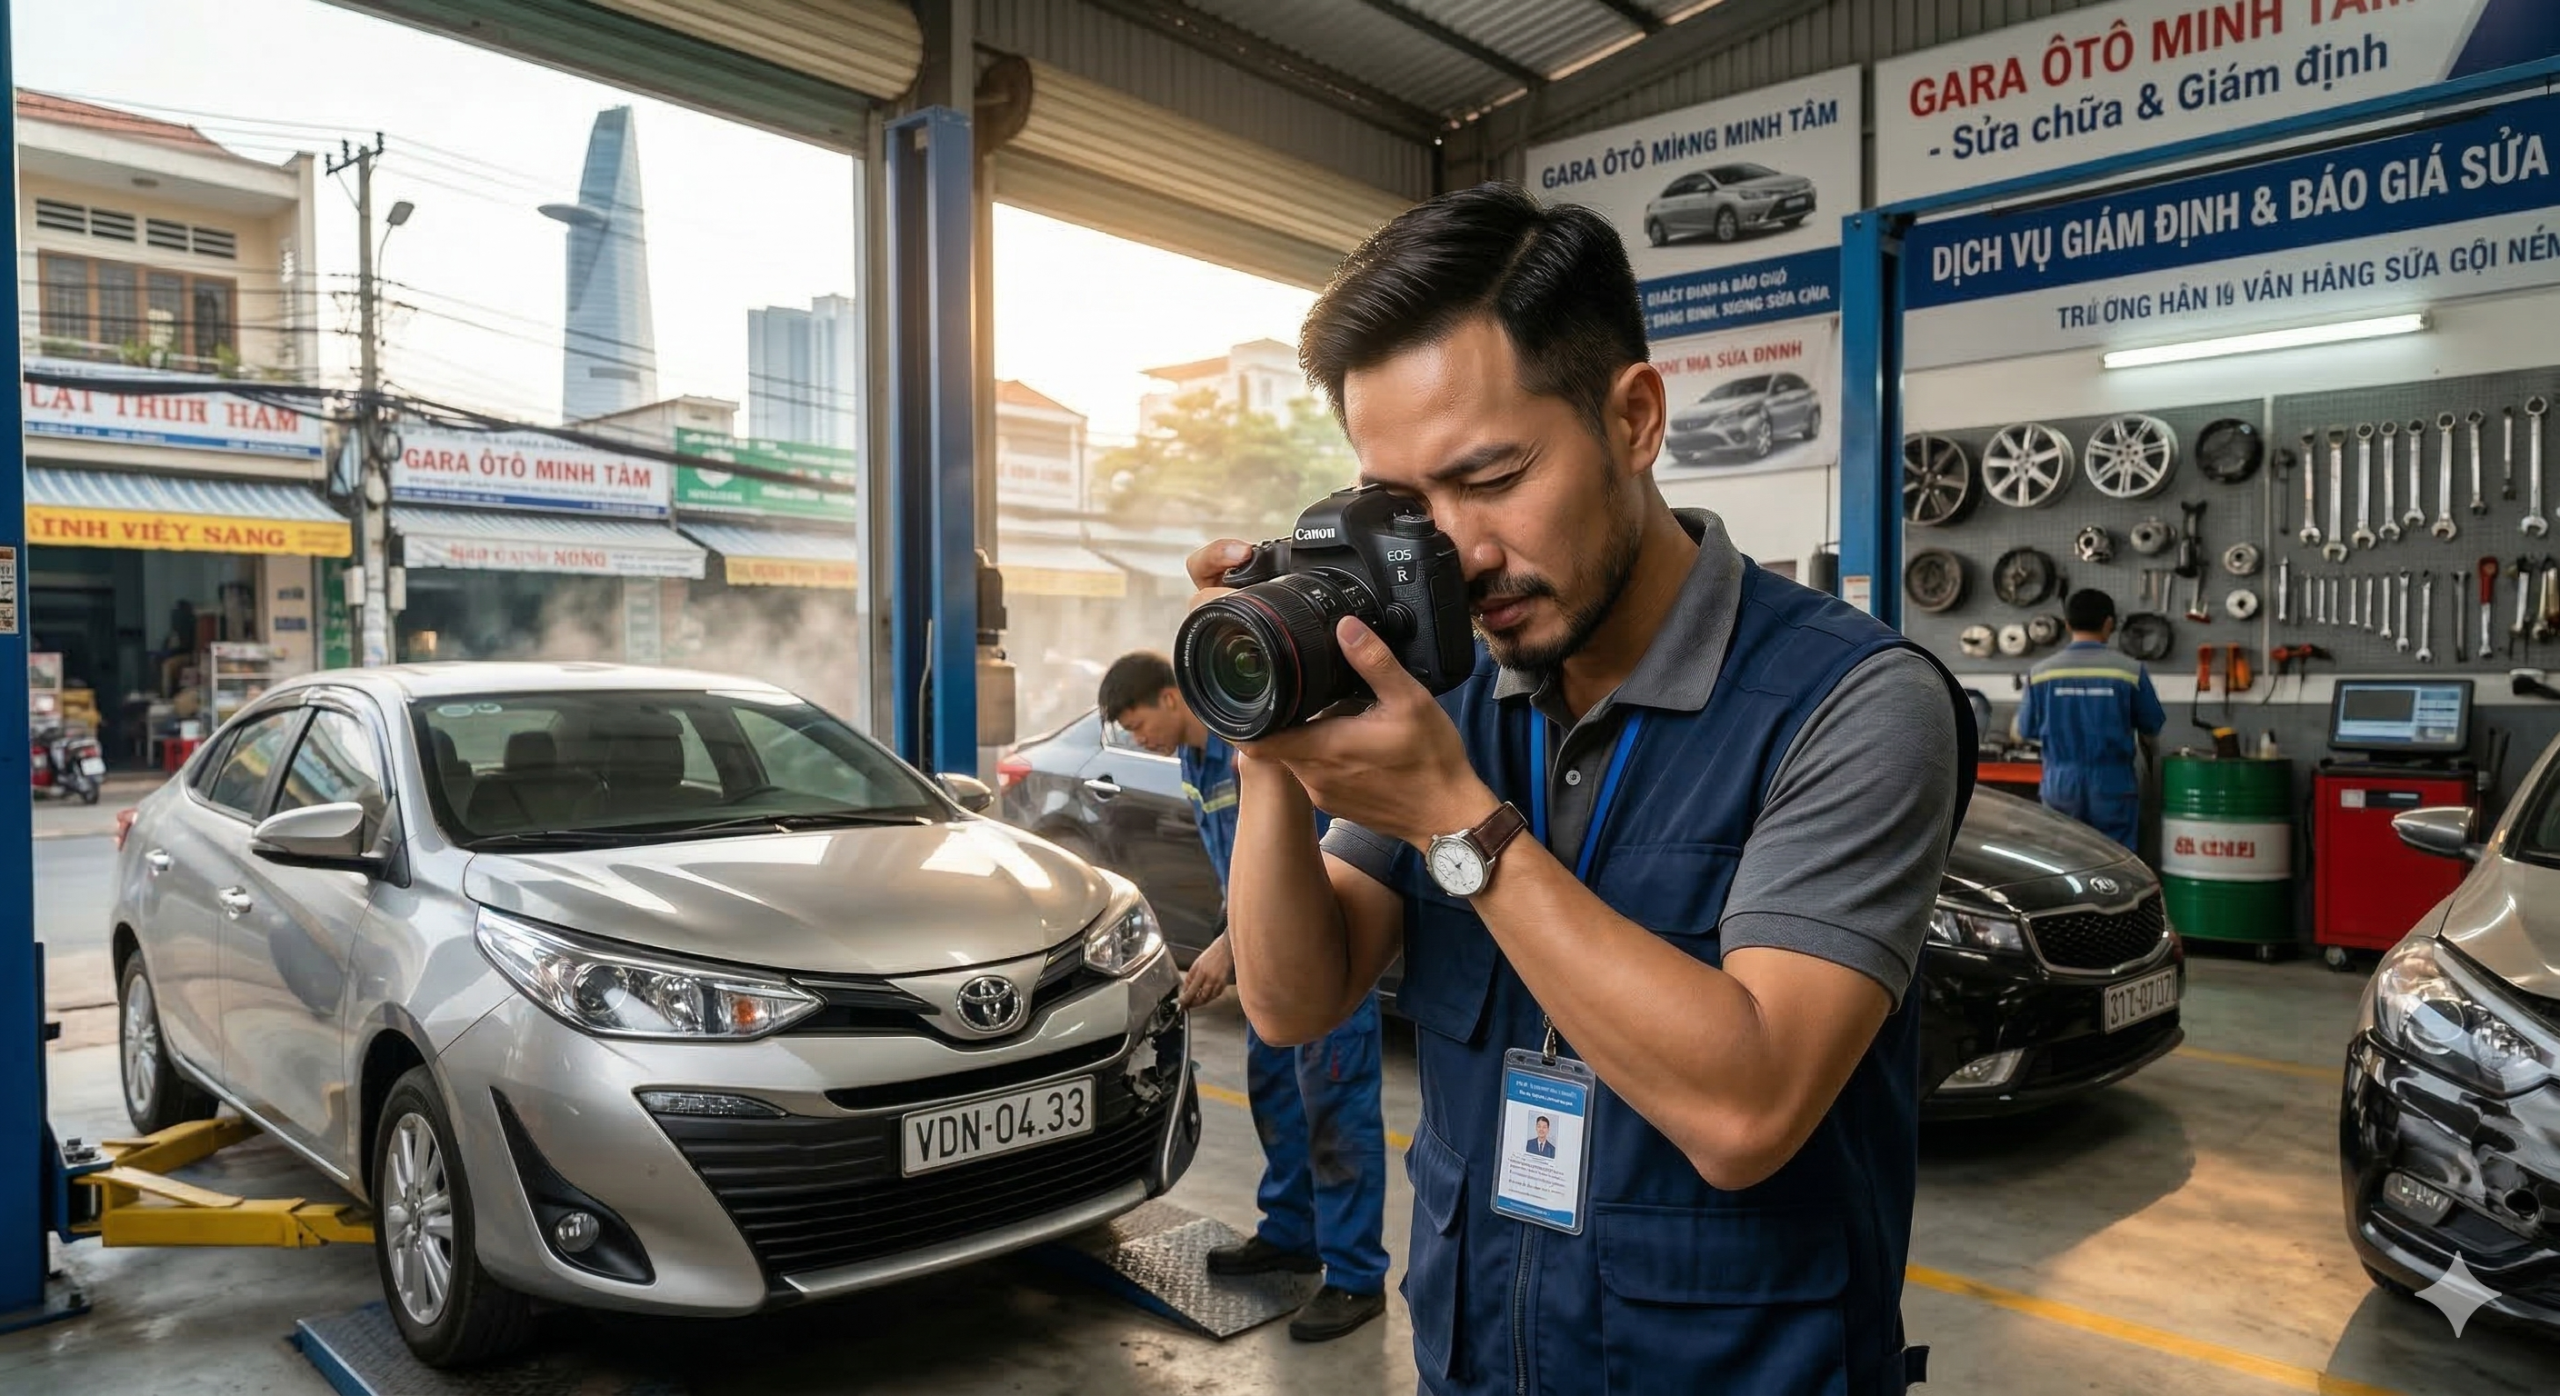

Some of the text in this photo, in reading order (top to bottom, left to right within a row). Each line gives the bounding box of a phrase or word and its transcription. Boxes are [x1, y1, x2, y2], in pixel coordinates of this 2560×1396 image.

[1909, 56, 2027, 117] GARA
[2042, 19, 2134, 86] ÔTÔ
[2152, 0, 2283, 61] MINH
[1953, 115, 2019, 159] Sửa
[2032, 96, 2122, 142] chữa
[2137, 83, 2163, 120] &
[2178, 63, 2280, 111] Giám
[2295, 33, 2388, 91] định
[1542, 157, 1597, 189] GARA
[1603, 140, 1645, 175] ÔTÔ
[1725, 113, 1781, 148] MINH
[1788, 99, 1837, 132] TÂM
[1933, 126, 2550, 286] DỊCH VỤ GIÁM ĐỊNH & BÁO GIÁ SỬA
[405, 448, 470, 474] GARA
[480, 448, 526, 478] ÔTÔ
[536, 459, 595, 484] MINH
[1295, 527, 1336, 541] Canon
[1387, 549, 1412, 561] EOS
[916, 1087, 1085, 1162] VDN-04.33
